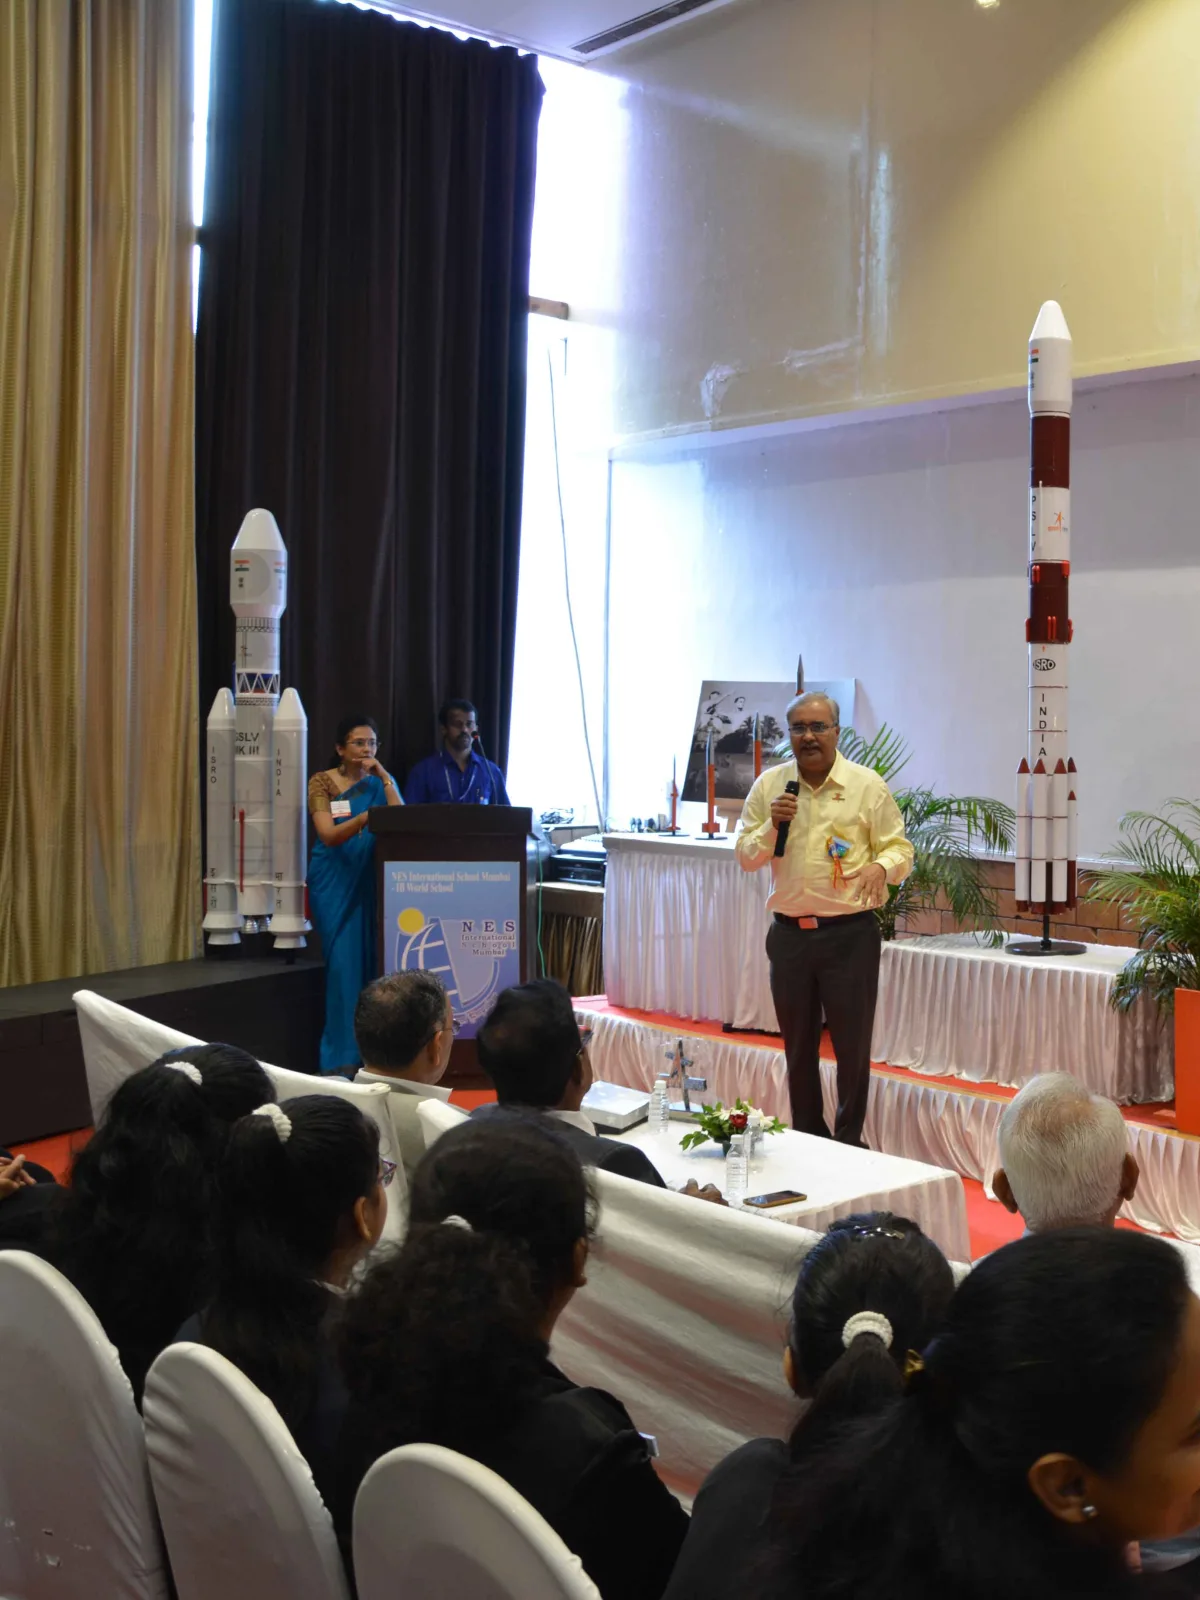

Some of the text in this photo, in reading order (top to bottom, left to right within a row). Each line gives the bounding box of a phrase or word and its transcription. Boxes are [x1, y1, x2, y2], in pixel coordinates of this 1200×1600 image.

[1039, 693, 1047, 757] INDIA
[391, 872, 511, 882] NES International School Mumbai
[396, 883, 405, 892] IB
[407, 883, 429, 892] World
[430, 883, 454, 892] School
